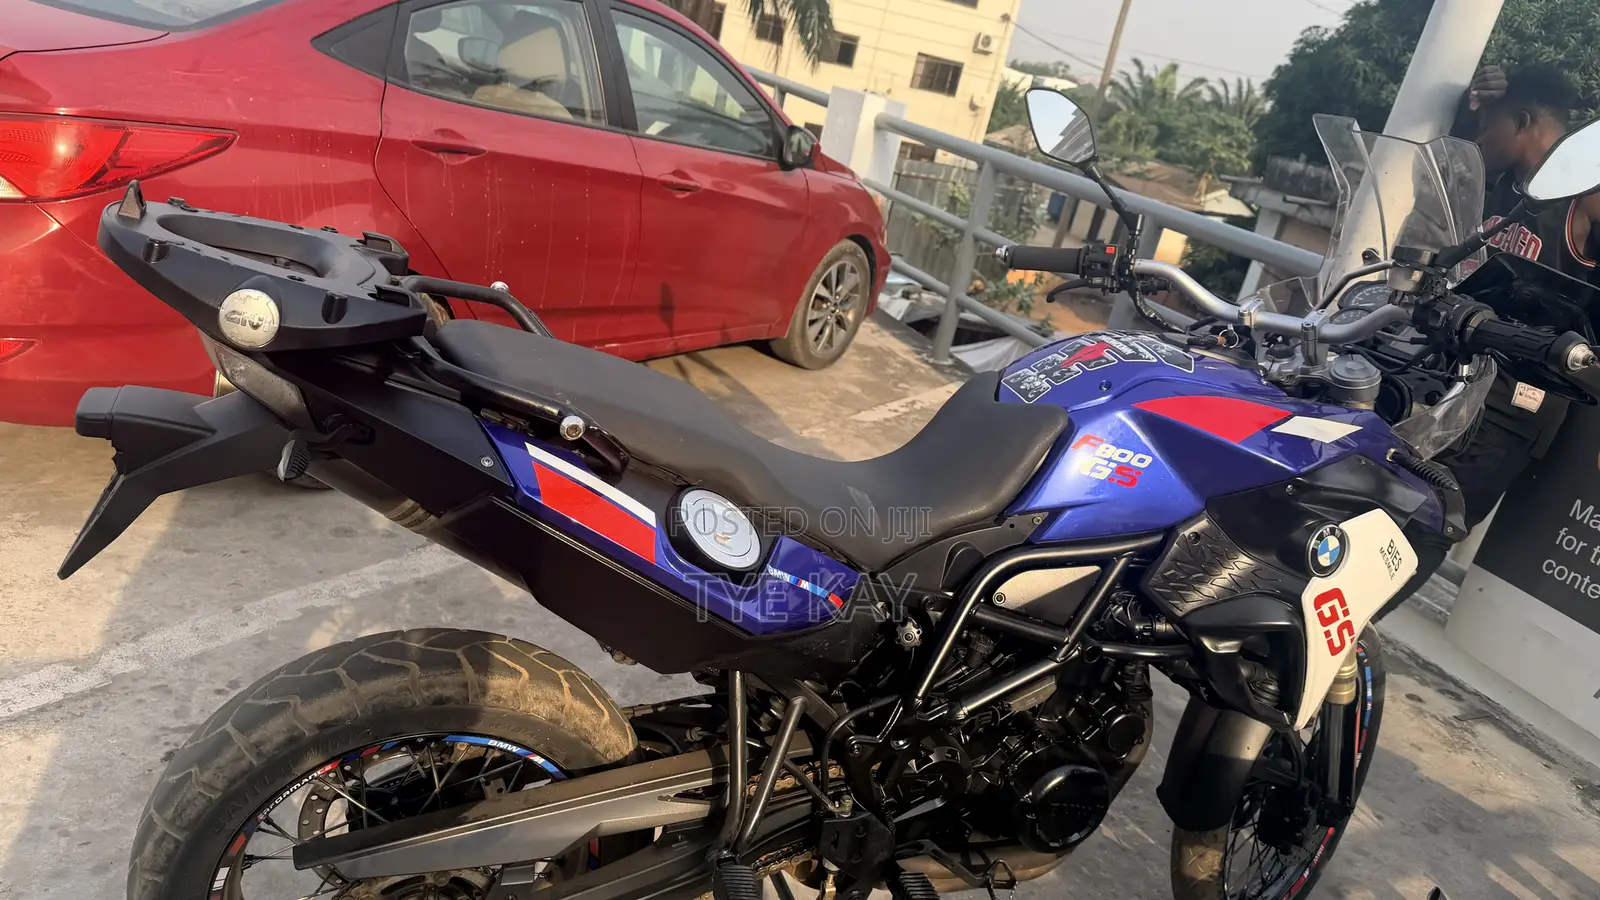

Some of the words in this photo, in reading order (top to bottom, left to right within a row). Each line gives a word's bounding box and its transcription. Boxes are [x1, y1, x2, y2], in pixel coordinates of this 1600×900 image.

[1312, 527, 1342, 549] BMW
[1555, 527, 1588, 555] for
[767, 564, 791, 583] BMW
[1313, 587, 1356, 657] GS
[487, 739, 520, 752] BMW
